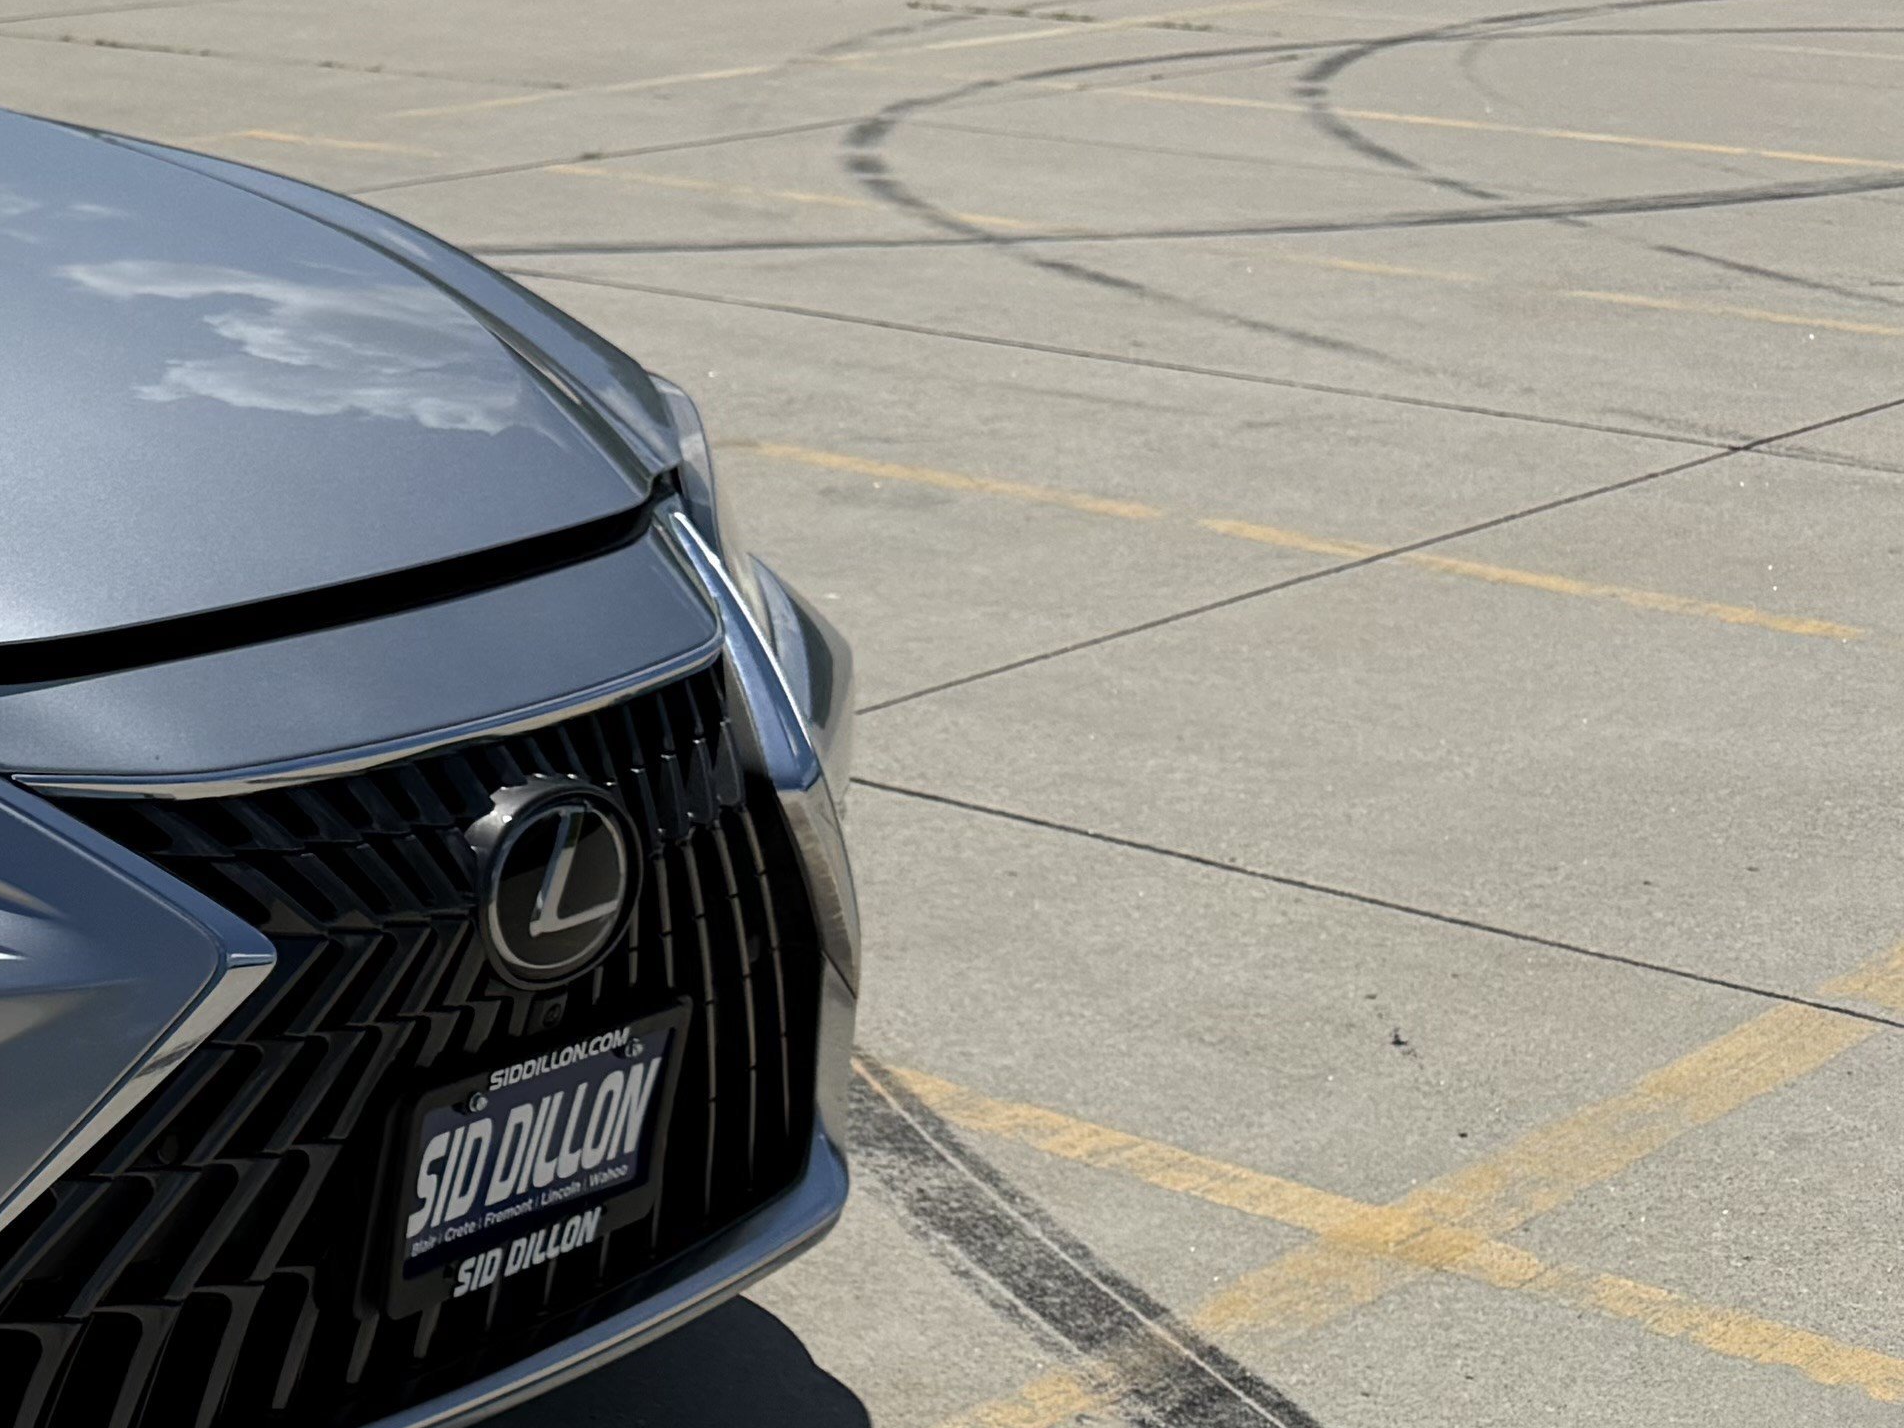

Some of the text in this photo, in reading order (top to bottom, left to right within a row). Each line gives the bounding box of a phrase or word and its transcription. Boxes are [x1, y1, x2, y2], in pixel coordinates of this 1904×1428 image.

[489, 1027, 630, 1091] SIDDILLON.COM
[405, 1057, 663, 1239] SID DILLON
[444, 1221, 477, 1243] Crete
[483, 1199, 534, 1228] Fremont
[541, 1181, 582, 1206] Lincoln
[589, 1164, 629, 1187] Wahoo
[453, 1206, 602, 1298] SID DILLON
